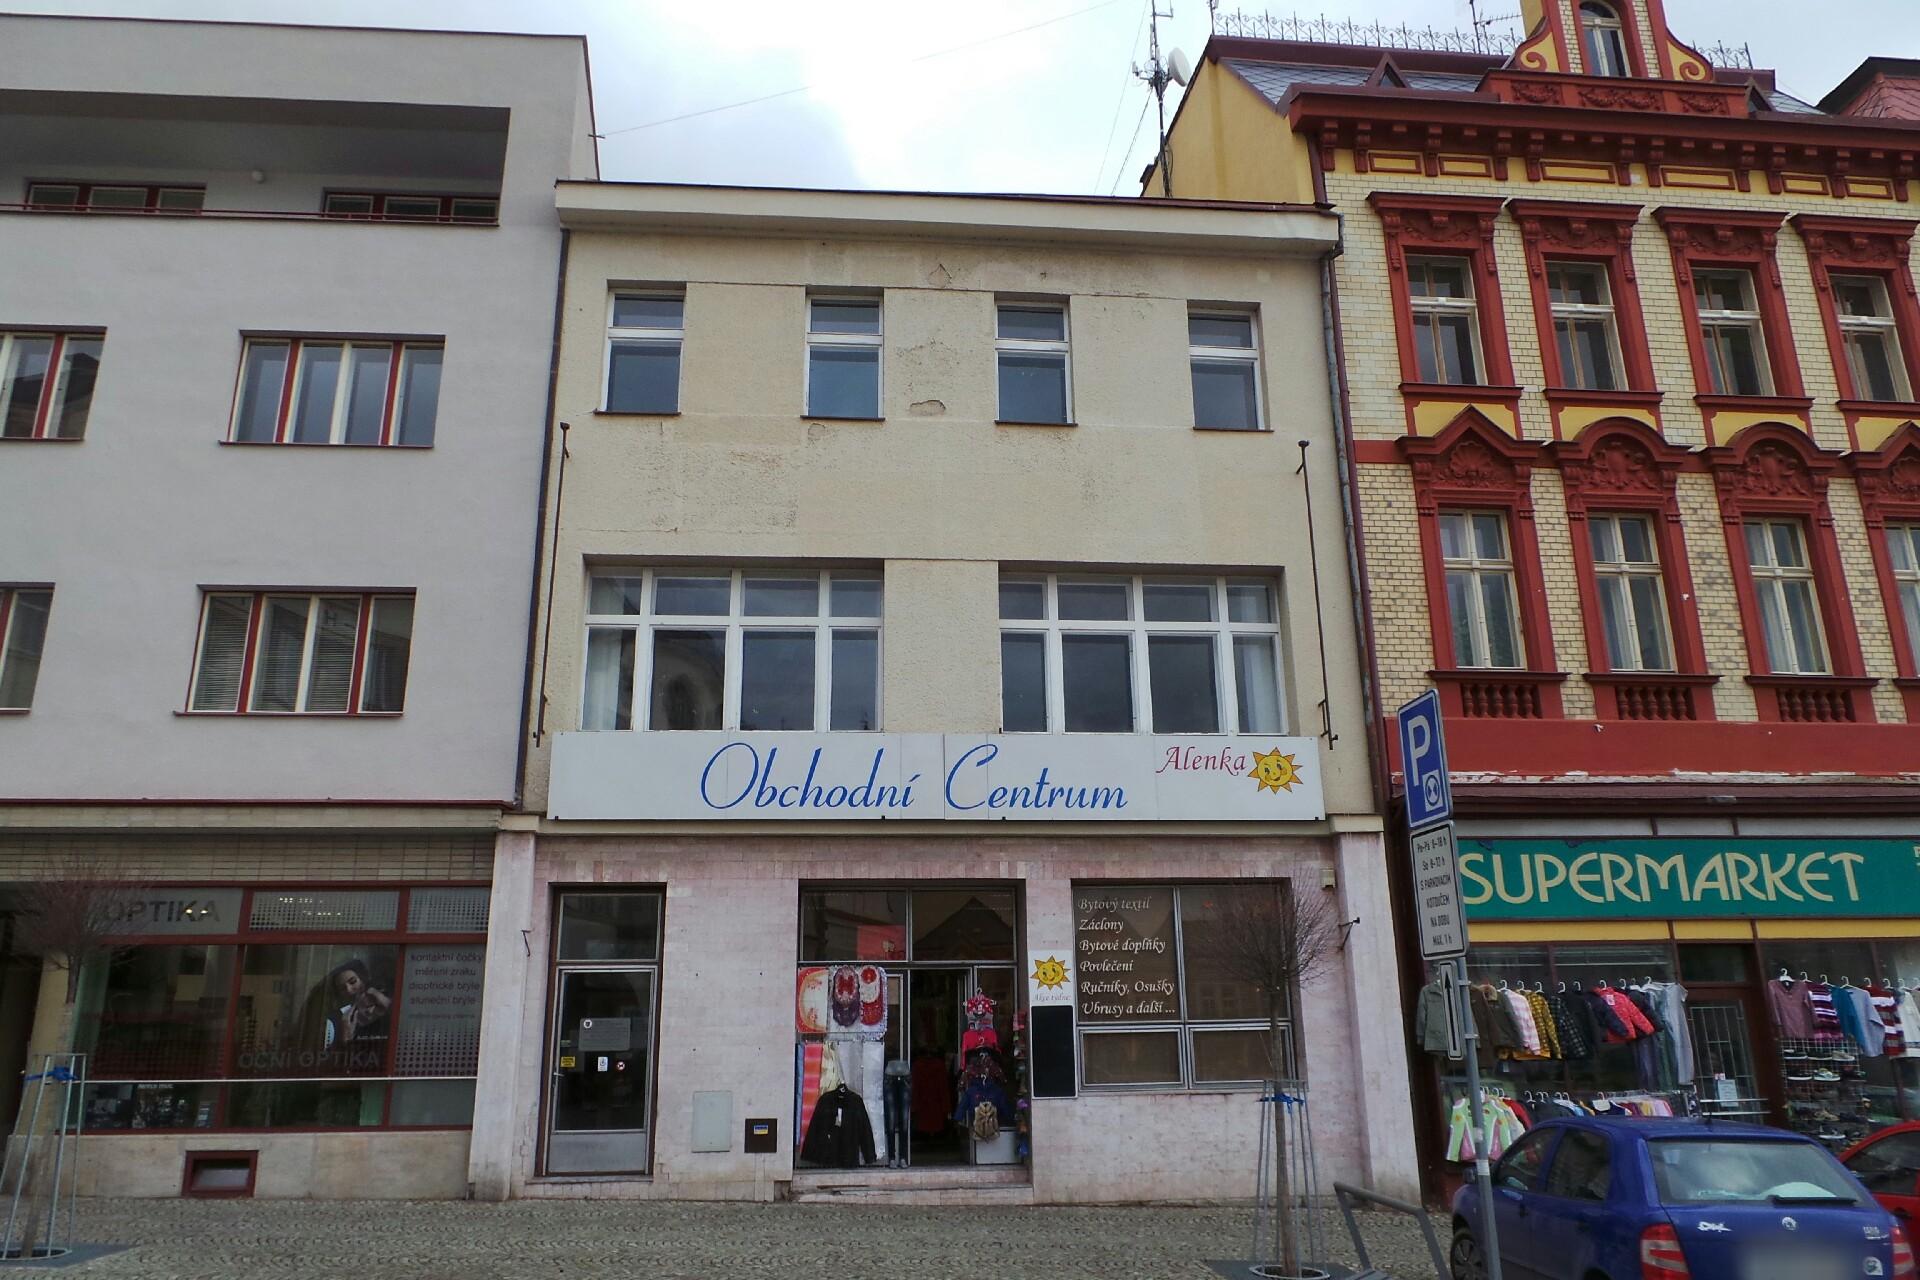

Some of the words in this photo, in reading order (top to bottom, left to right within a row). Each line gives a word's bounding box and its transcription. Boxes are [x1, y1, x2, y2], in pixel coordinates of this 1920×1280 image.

[1407, 714, 1431, 787] P
[1155, 746, 1247, 776] Alenka
[701, 742, 921, 810] Obchodní
[944, 743, 1127, 811] Centrum
[1460, 852, 1865, 905] SUPERMARKET
[1078, 896, 1118, 914] Bytový
[1079, 918, 1124, 934] Záclony
[1079, 940, 1119, 955] Bytové
[1121, 937, 1167, 954] doplňky
[1079, 959, 1134, 973] Povlečení
[1080, 981, 1130, 996] Ručníky,
[1134, 980, 1175, 995] Osušky
[1082, 1001, 1124, 1017] Ubrusy
[1136, 1001, 1164, 1014] další
